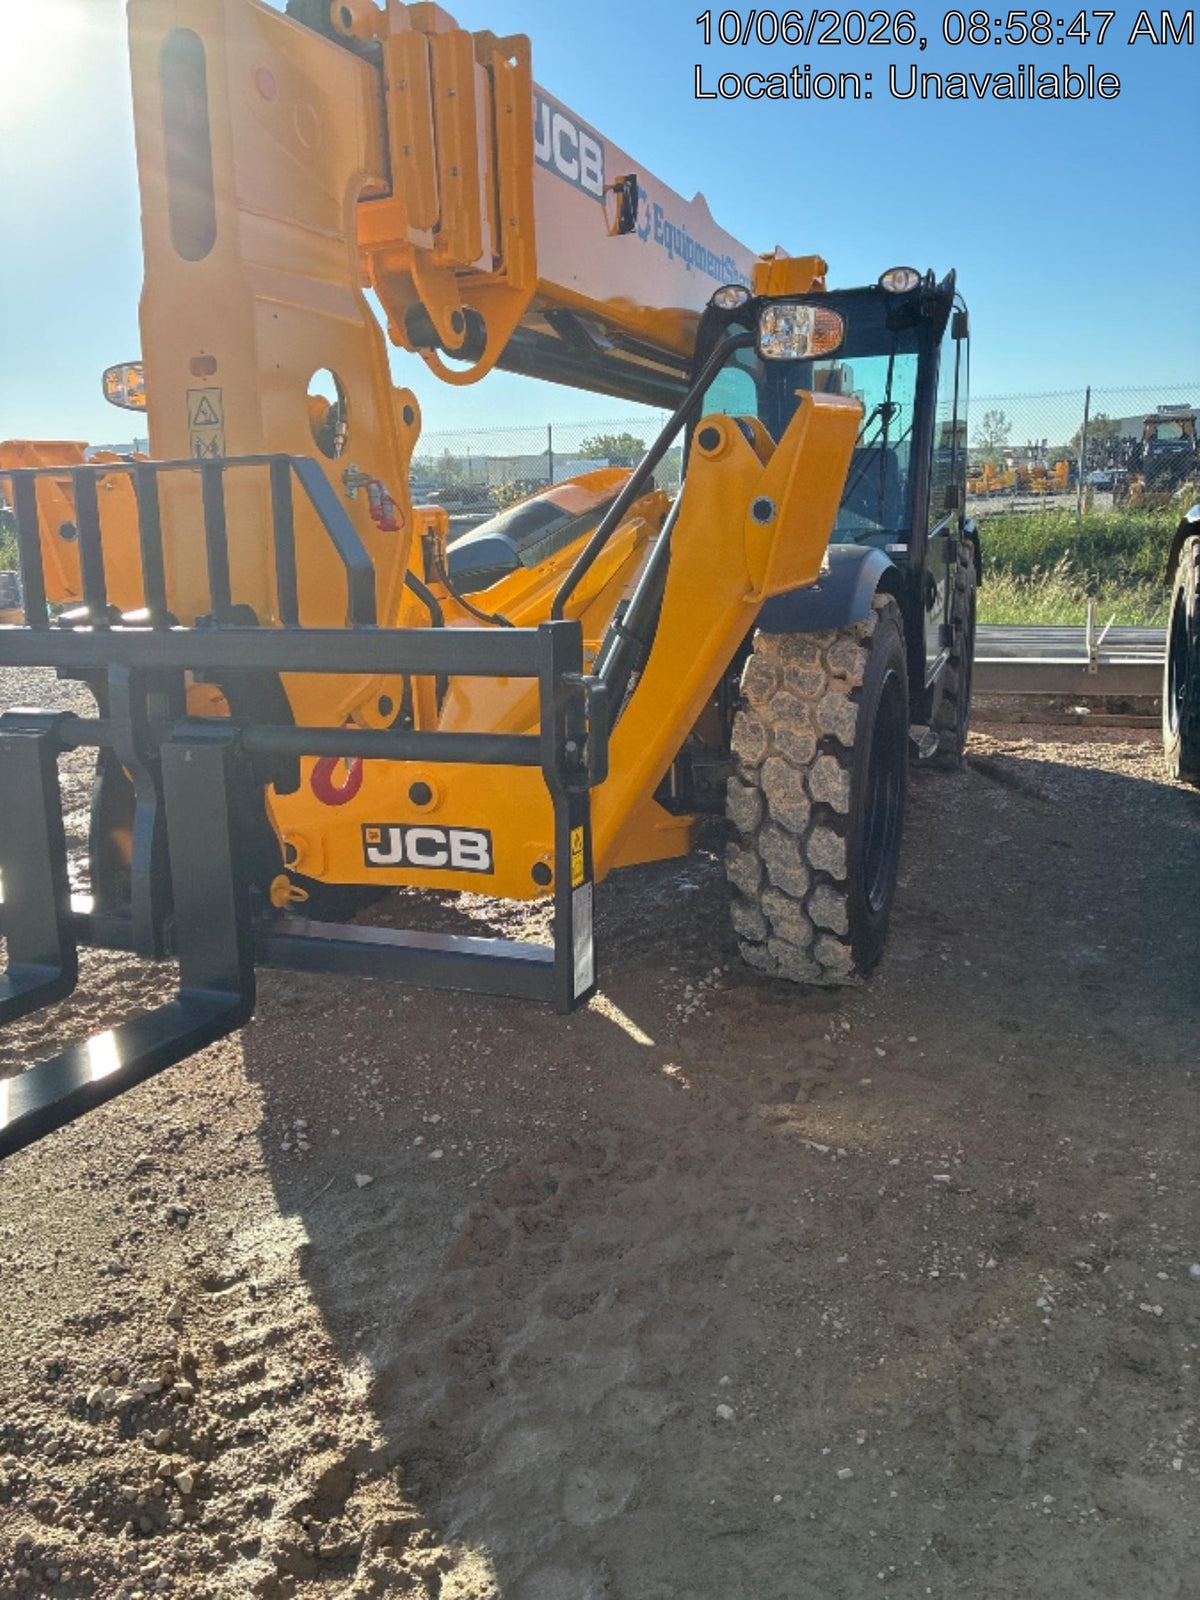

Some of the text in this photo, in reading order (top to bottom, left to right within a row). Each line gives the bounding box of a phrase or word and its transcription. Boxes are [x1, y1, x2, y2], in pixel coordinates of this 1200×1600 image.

[534, 102, 603, 197] JCB
[653, 202, 752, 288] EquipmentSha
[367, 827, 492, 870] JCB
